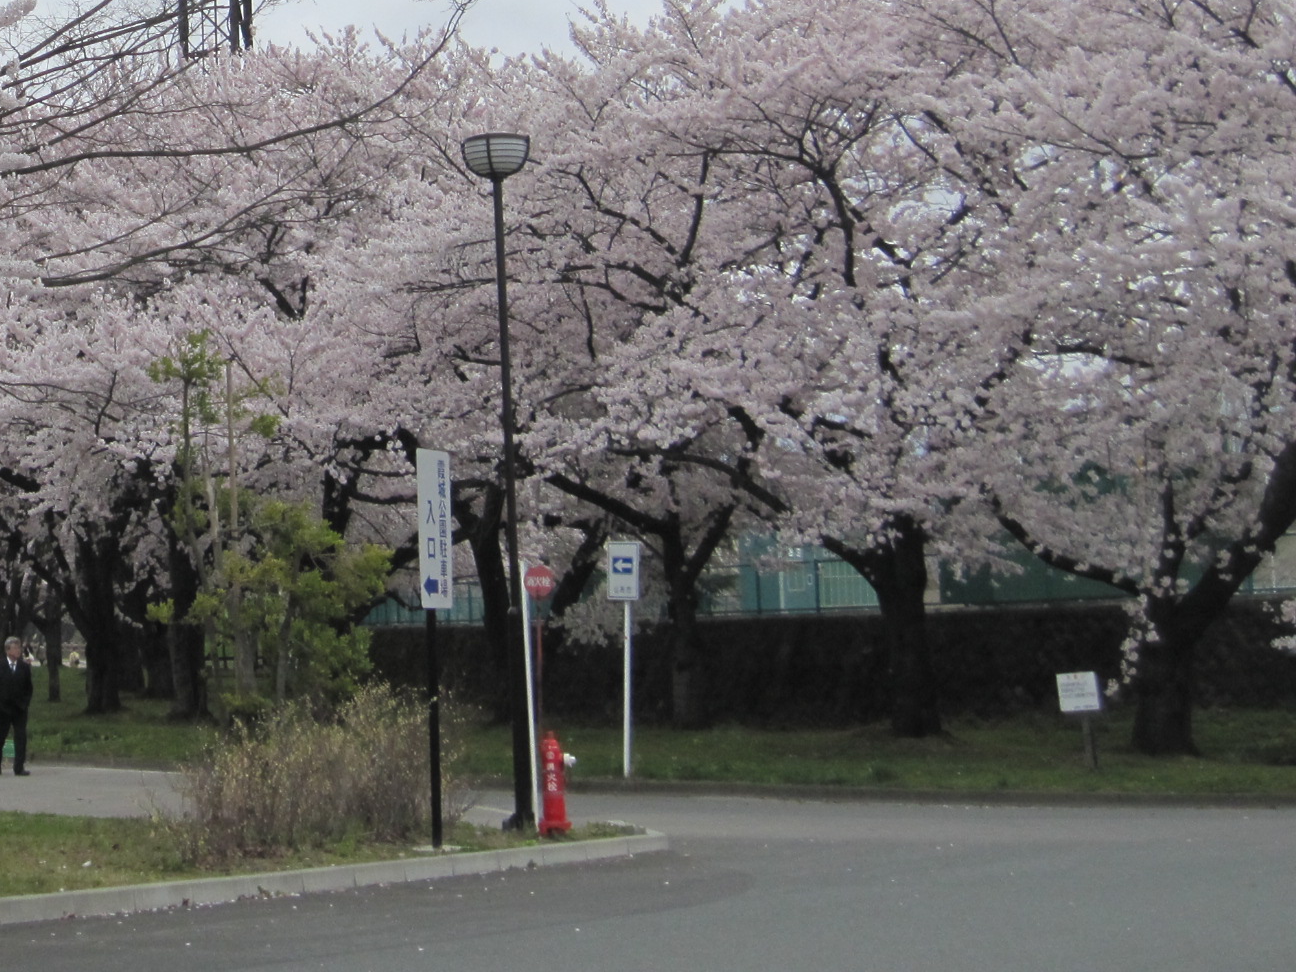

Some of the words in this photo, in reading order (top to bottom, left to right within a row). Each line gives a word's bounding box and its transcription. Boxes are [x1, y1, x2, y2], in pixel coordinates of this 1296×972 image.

[426, 500, 435, 559] 入口
[527, 576, 551, 587] 消火栓
